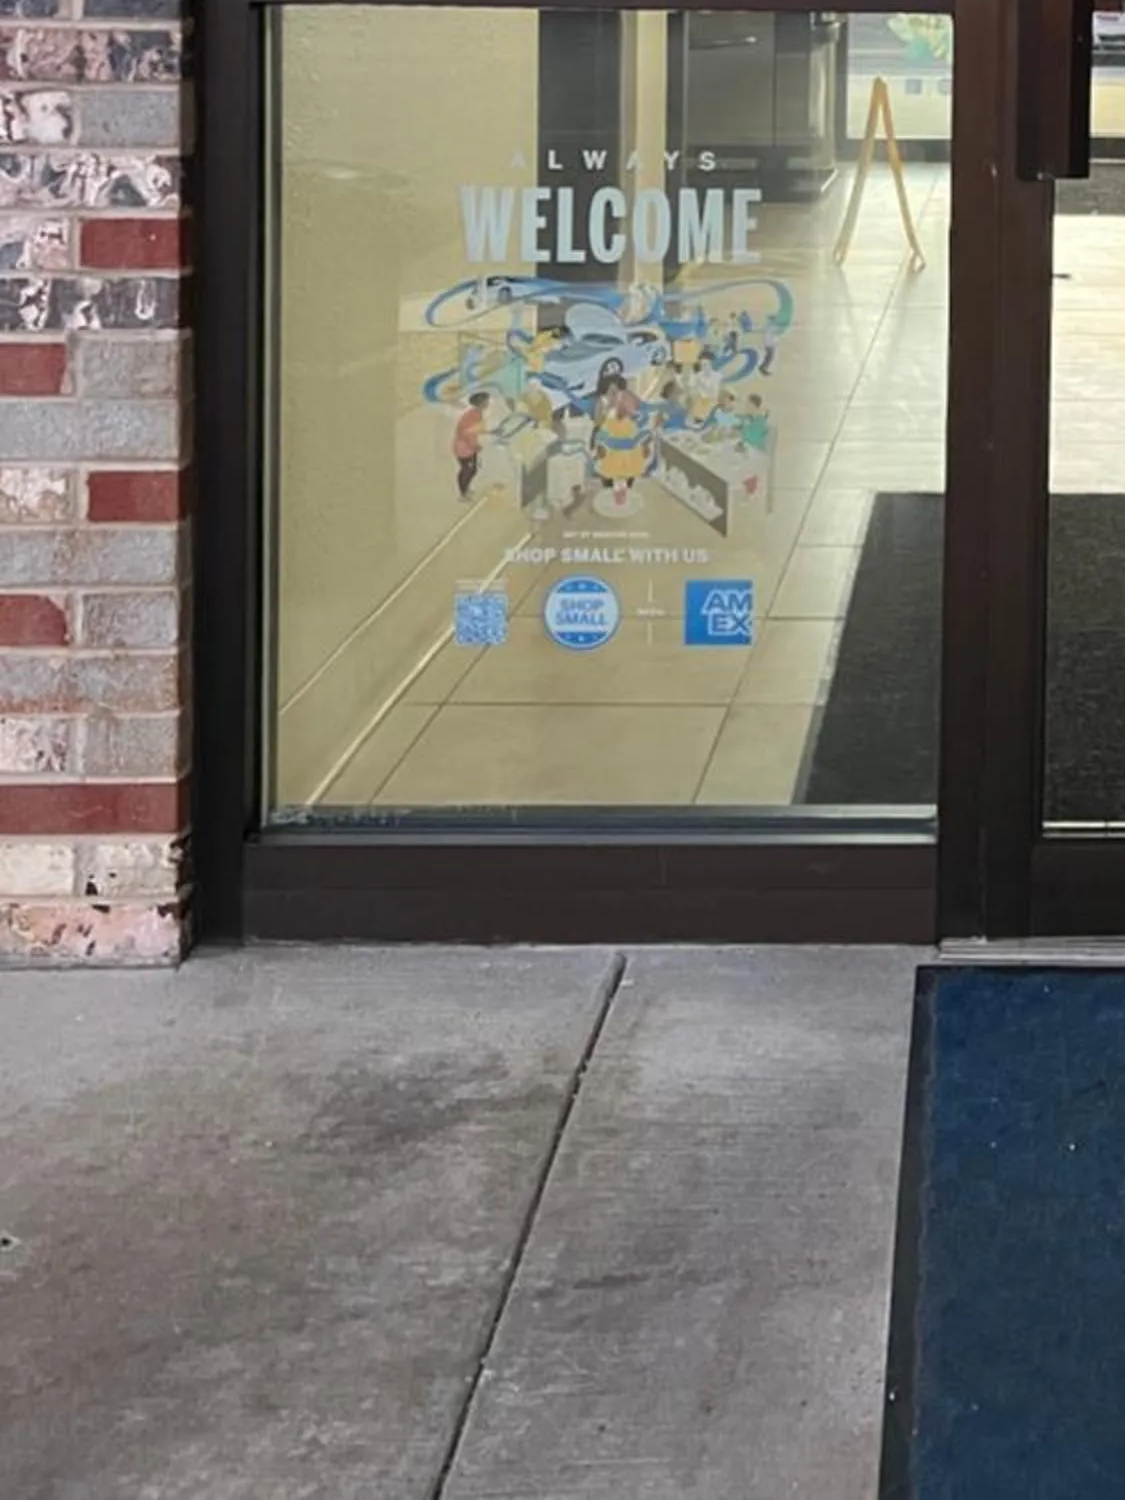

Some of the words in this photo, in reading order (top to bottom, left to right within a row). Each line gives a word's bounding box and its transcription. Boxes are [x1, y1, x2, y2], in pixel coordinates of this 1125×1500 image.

[509, 149, 717, 172] ALWAYS
[460, 186, 762, 264] WELCOME
[505, 547, 557, 563] SHOP
[629, 548, 679, 565] WITH
[683, 548, 710, 565] US
[560, 599, 606, 612] SHOP
[556, 612, 608, 626] SMALL
